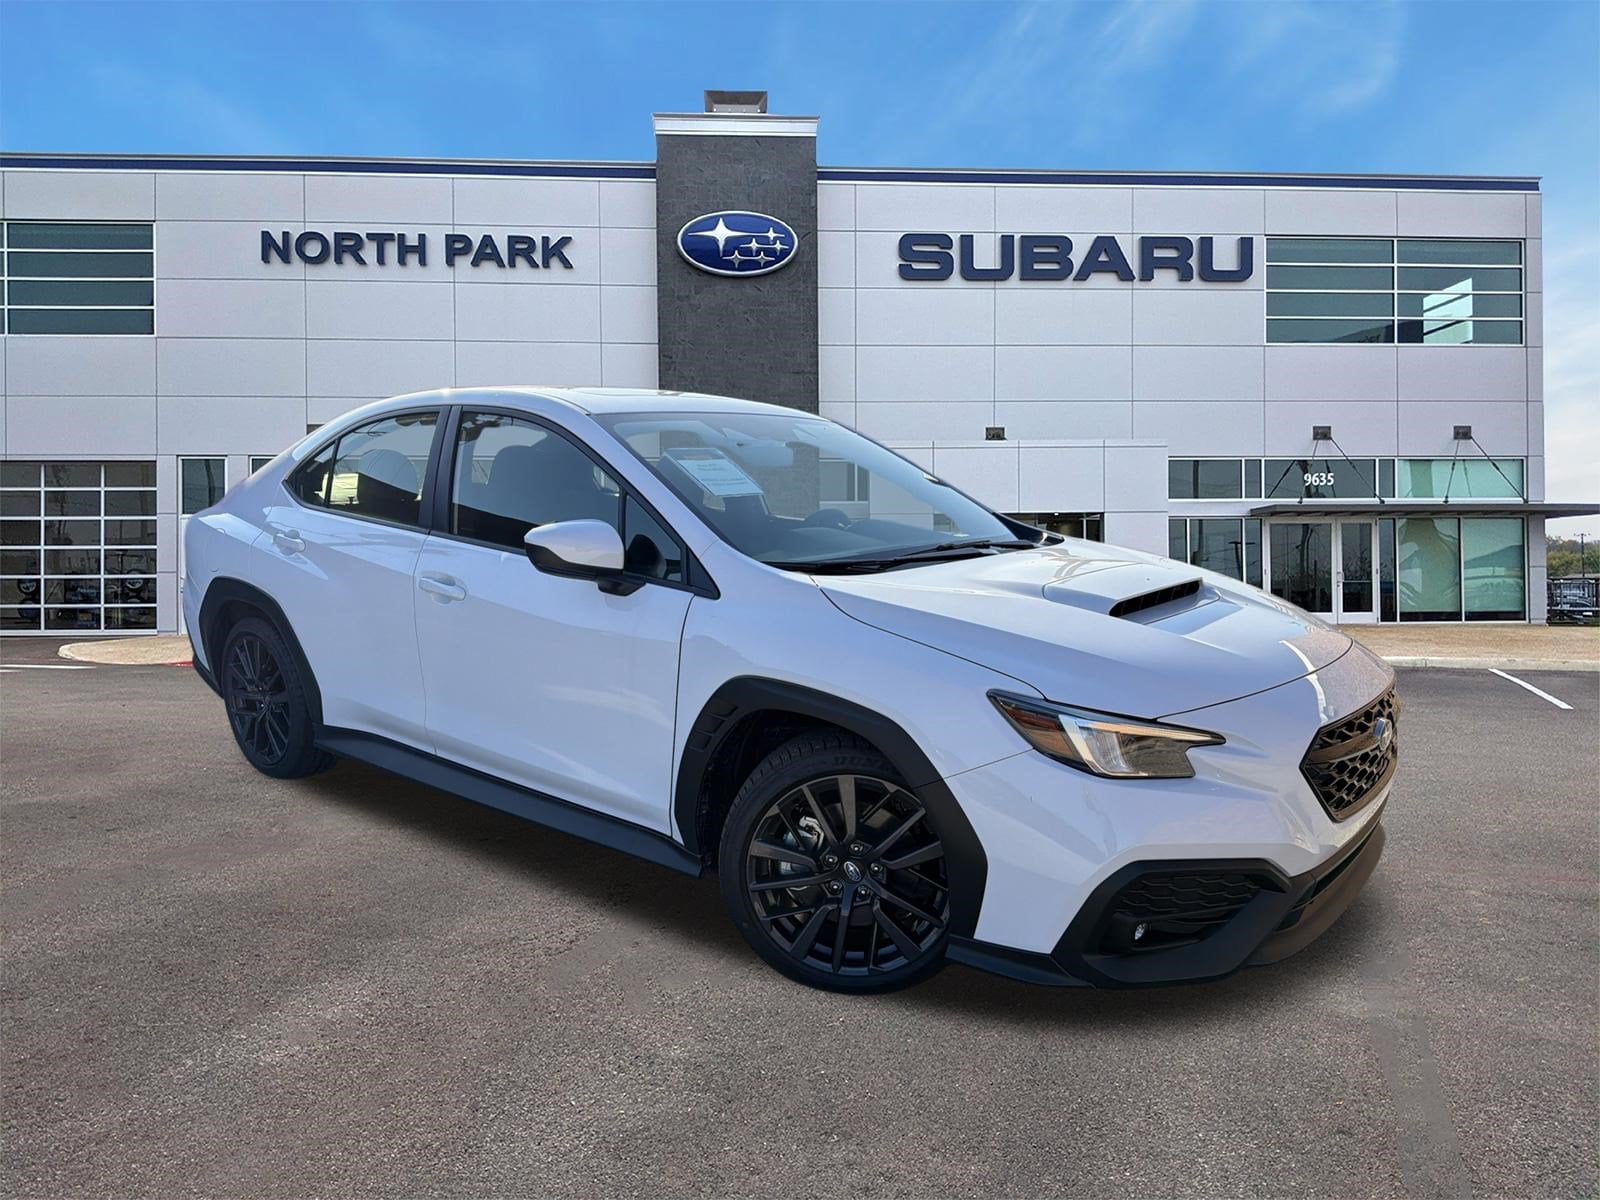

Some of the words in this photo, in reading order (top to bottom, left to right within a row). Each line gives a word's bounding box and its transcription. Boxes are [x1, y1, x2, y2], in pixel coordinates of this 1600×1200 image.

[260, 230, 427, 267] NORTH
[445, 233, 574, 269] PARK
[898, 232, 1254, 283] SUBARU
[1303, 472, 1335, 487] 9635
